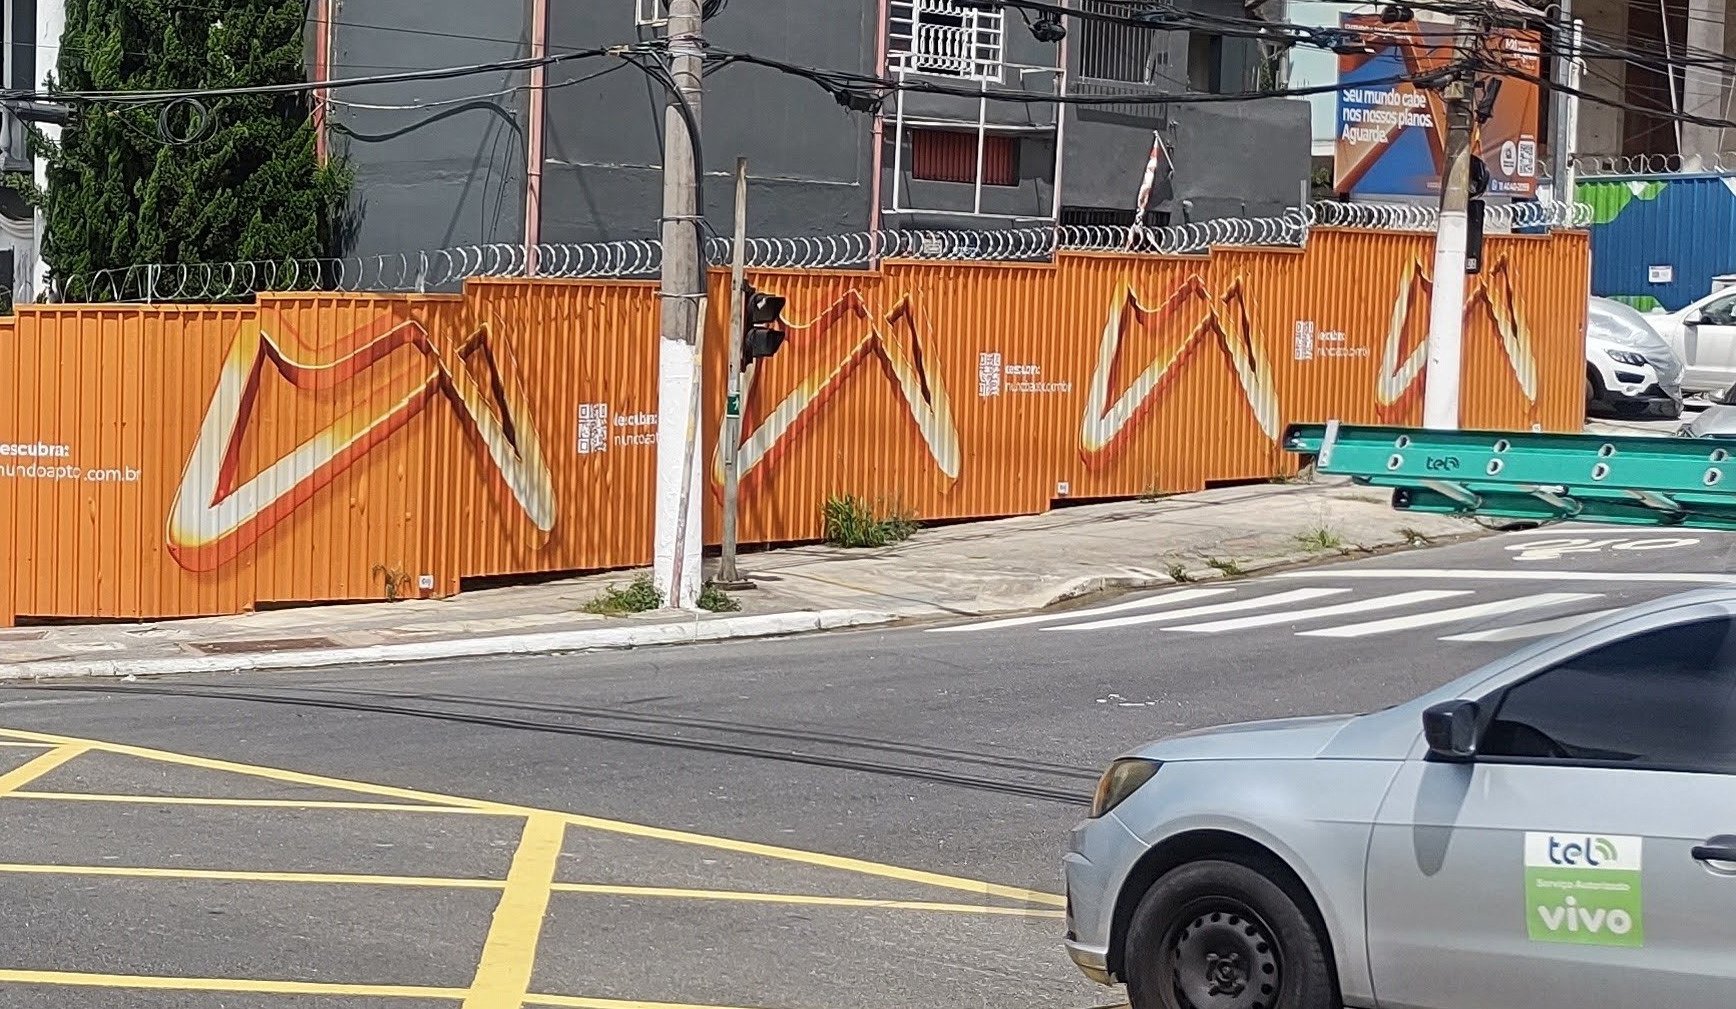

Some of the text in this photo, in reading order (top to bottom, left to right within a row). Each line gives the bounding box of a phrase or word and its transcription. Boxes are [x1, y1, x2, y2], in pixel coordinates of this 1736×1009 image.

[1343, 88, 1426, 108] Seu mundo cabe
[1343, 107, 1433, 130] nos nossos planos.
[1343, 123, 1388, 145] Aguarde.
[1537, 895, 1633, 935] vivo
